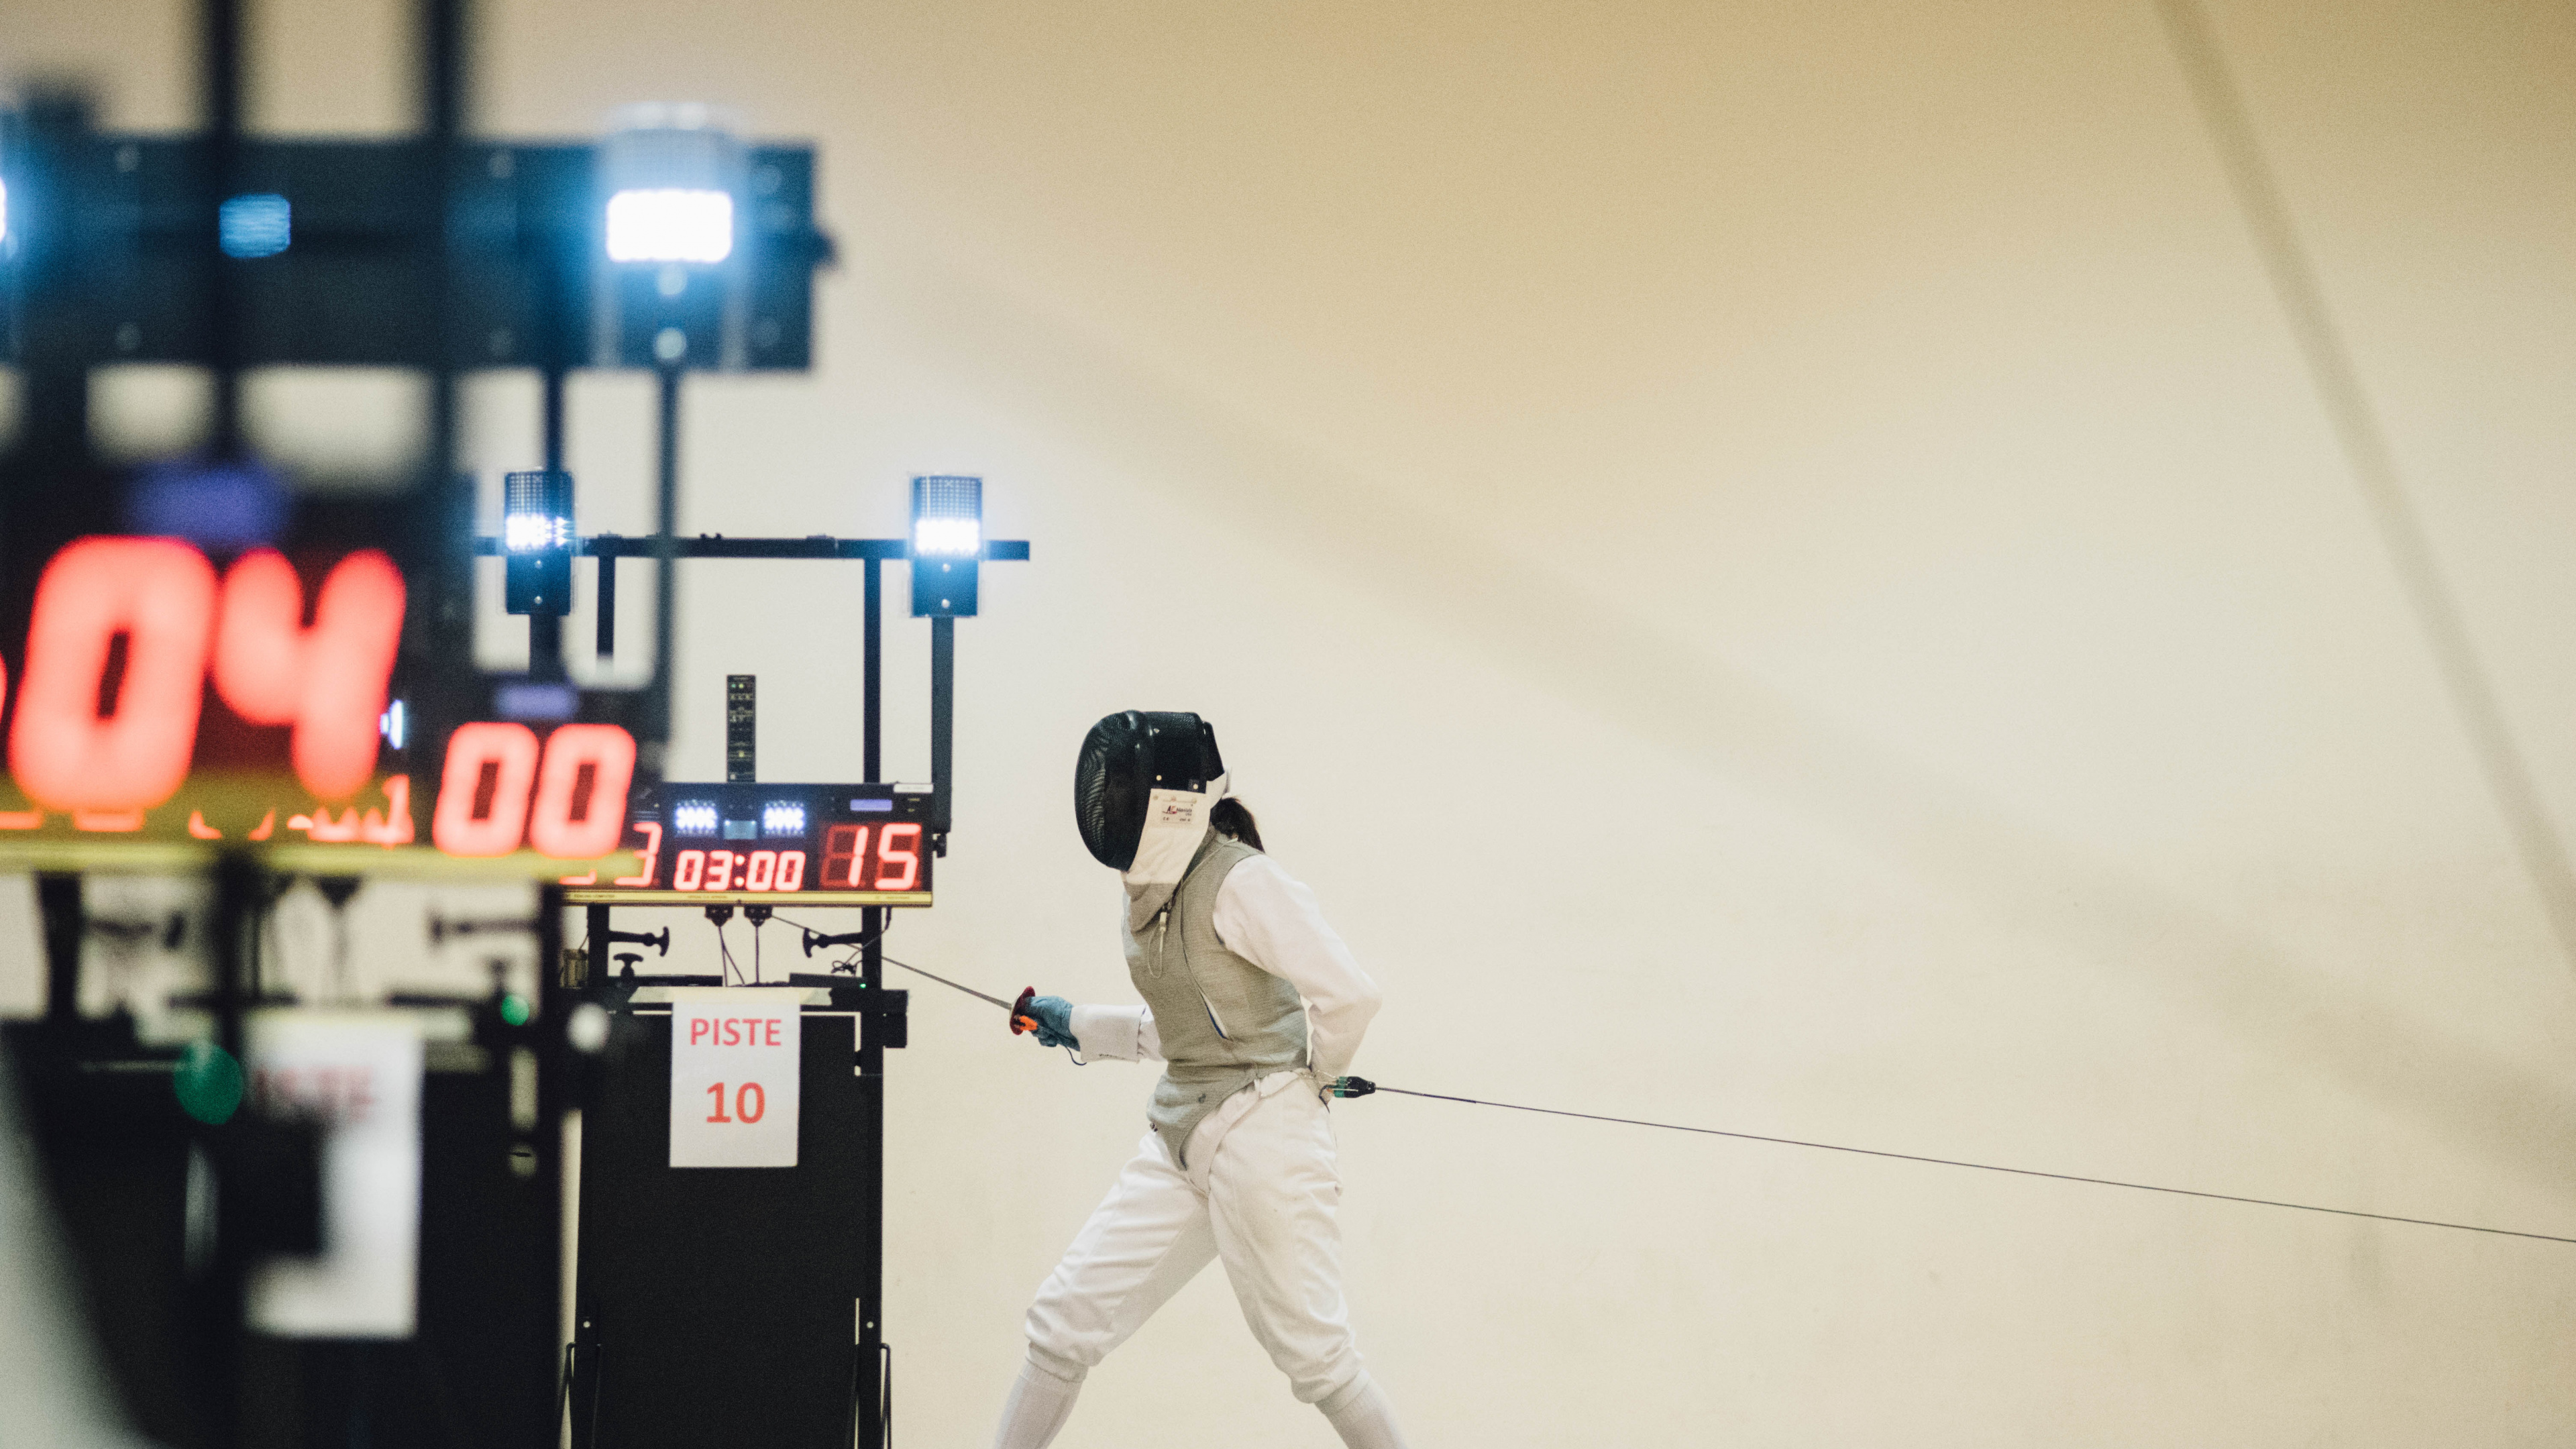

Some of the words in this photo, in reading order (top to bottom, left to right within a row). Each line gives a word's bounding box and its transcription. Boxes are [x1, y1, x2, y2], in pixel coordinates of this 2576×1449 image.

[8, 535, 407, 812] 04
[432, 722, 637, 859] 00
[674, 849, 806, 892] 03:00
[847, 822, 922, 891] 15
[690, 1018, 782, 1046] PISTE
[706, 1082, 765, 1124] 10
